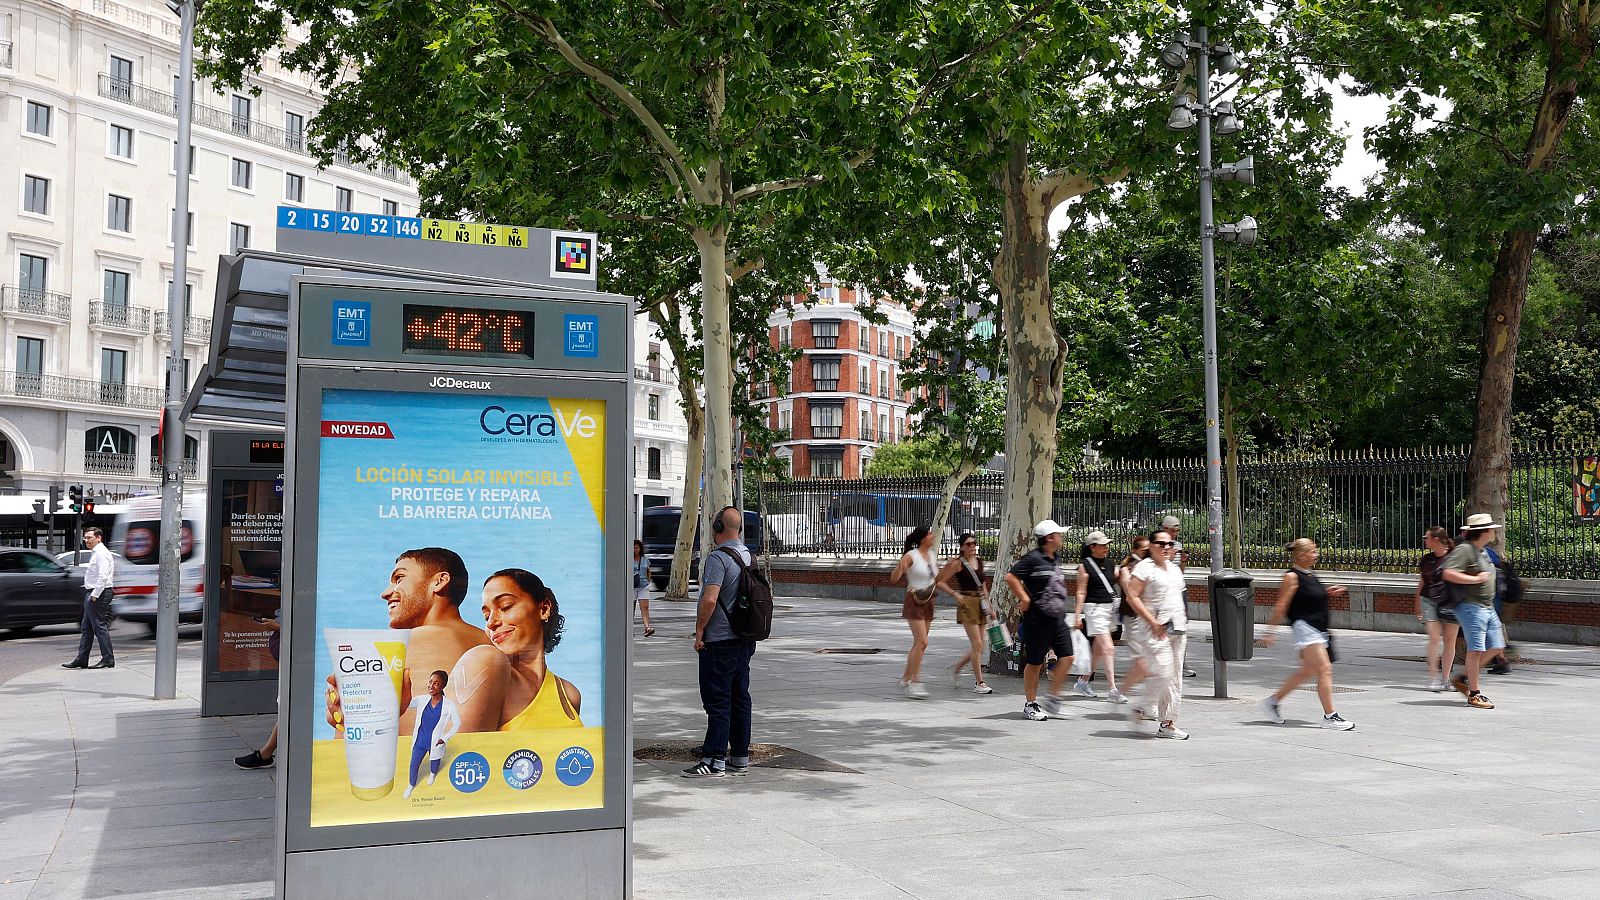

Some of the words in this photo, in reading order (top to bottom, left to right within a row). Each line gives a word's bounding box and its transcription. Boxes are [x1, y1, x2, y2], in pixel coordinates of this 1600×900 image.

[287, 211, 297, 226] 2
[313, 213, 330, 229] 15
[341, 216, 360, 231] 20
[370, 218, 388, 233] 52
[396, 220, 419, 236] 146
[427, 228, 443, 240] N2
[455, 230, 470, 243] N3
[482, 233, 496, 245] N5
[508, 235, 522, 247] N6
[338, 307, 365, 318] EMT
[569, 321, 594, 331] EMT
[429, 376, 491, 390] JCDecaux
[331, 424, 386, 436] NOVEDAD
[480, 405, 597, 438] CeraVe
[98, 430, 117, 453] A
[356, 464, 422, 483] LOCIÓN
[427, 468, 485, 485] SOLAR
[489, 469, 573, 486] INVISIBLE
[391, 487, 464, 502] PROTEGE
[466, 488, 477, 501] Y
[480, 488, 541, 502] REPARA
[231, 512, 256, 520] Darles
[257, 512, 266, 520] lo
[379, 505, 400, 519] LA
[403, 505, 478, 519] BARRERA
[481, 503, 552, 520] CUTÁNEA
[246, 527, 280, 535] cuestión
[340, 656, 403, 673] CeraVe
[505, 751, 537, 768] CERAMIDAS
[559, 748, 590, 761] RESISTENTE
[455, 761, 469, 769] SPF
[517, 760, 529, 779] 3
[455, 768, 486, 785] 50+
[507, 769, 540, 788] ESENCIALES
